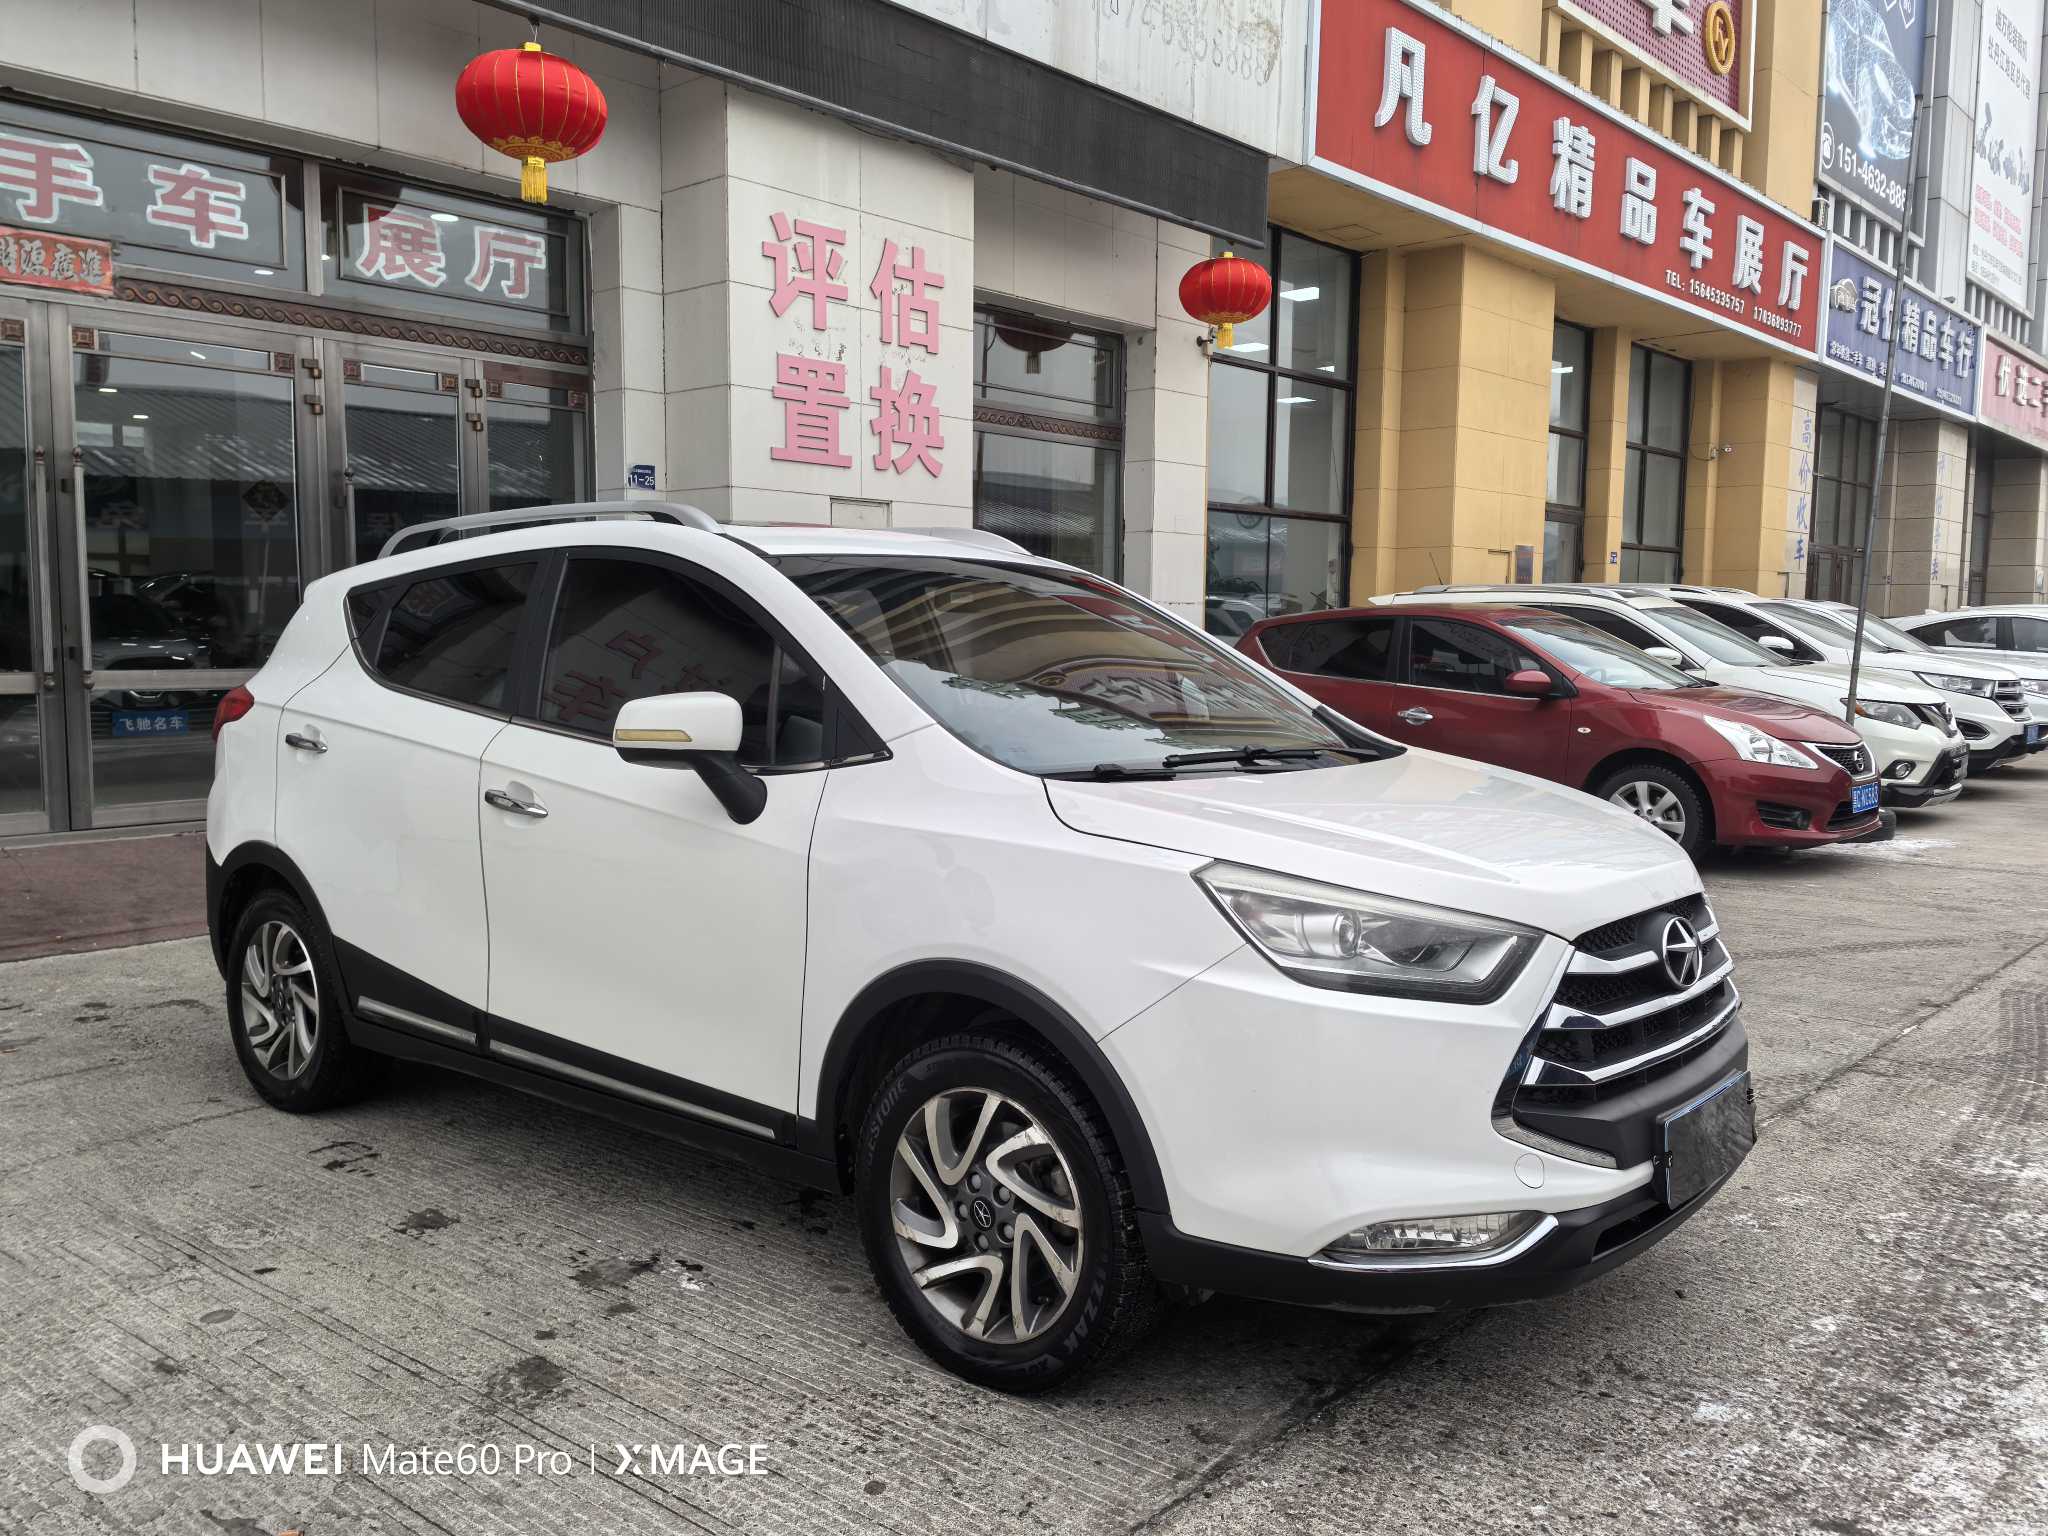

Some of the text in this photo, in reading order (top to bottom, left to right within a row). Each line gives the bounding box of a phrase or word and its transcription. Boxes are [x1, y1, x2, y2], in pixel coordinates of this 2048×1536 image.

[1373, 26, 1809, 311] 凡亿精品车展厅
[1837, 142, 1913, 215] 151-4632-888
[762, 211, 945, 355] 评估
[1665, 269, 1685, 291] TEL:
[771, 353, 945, 479] 置换
[119, 716, 184, 732] 飞驰名车
